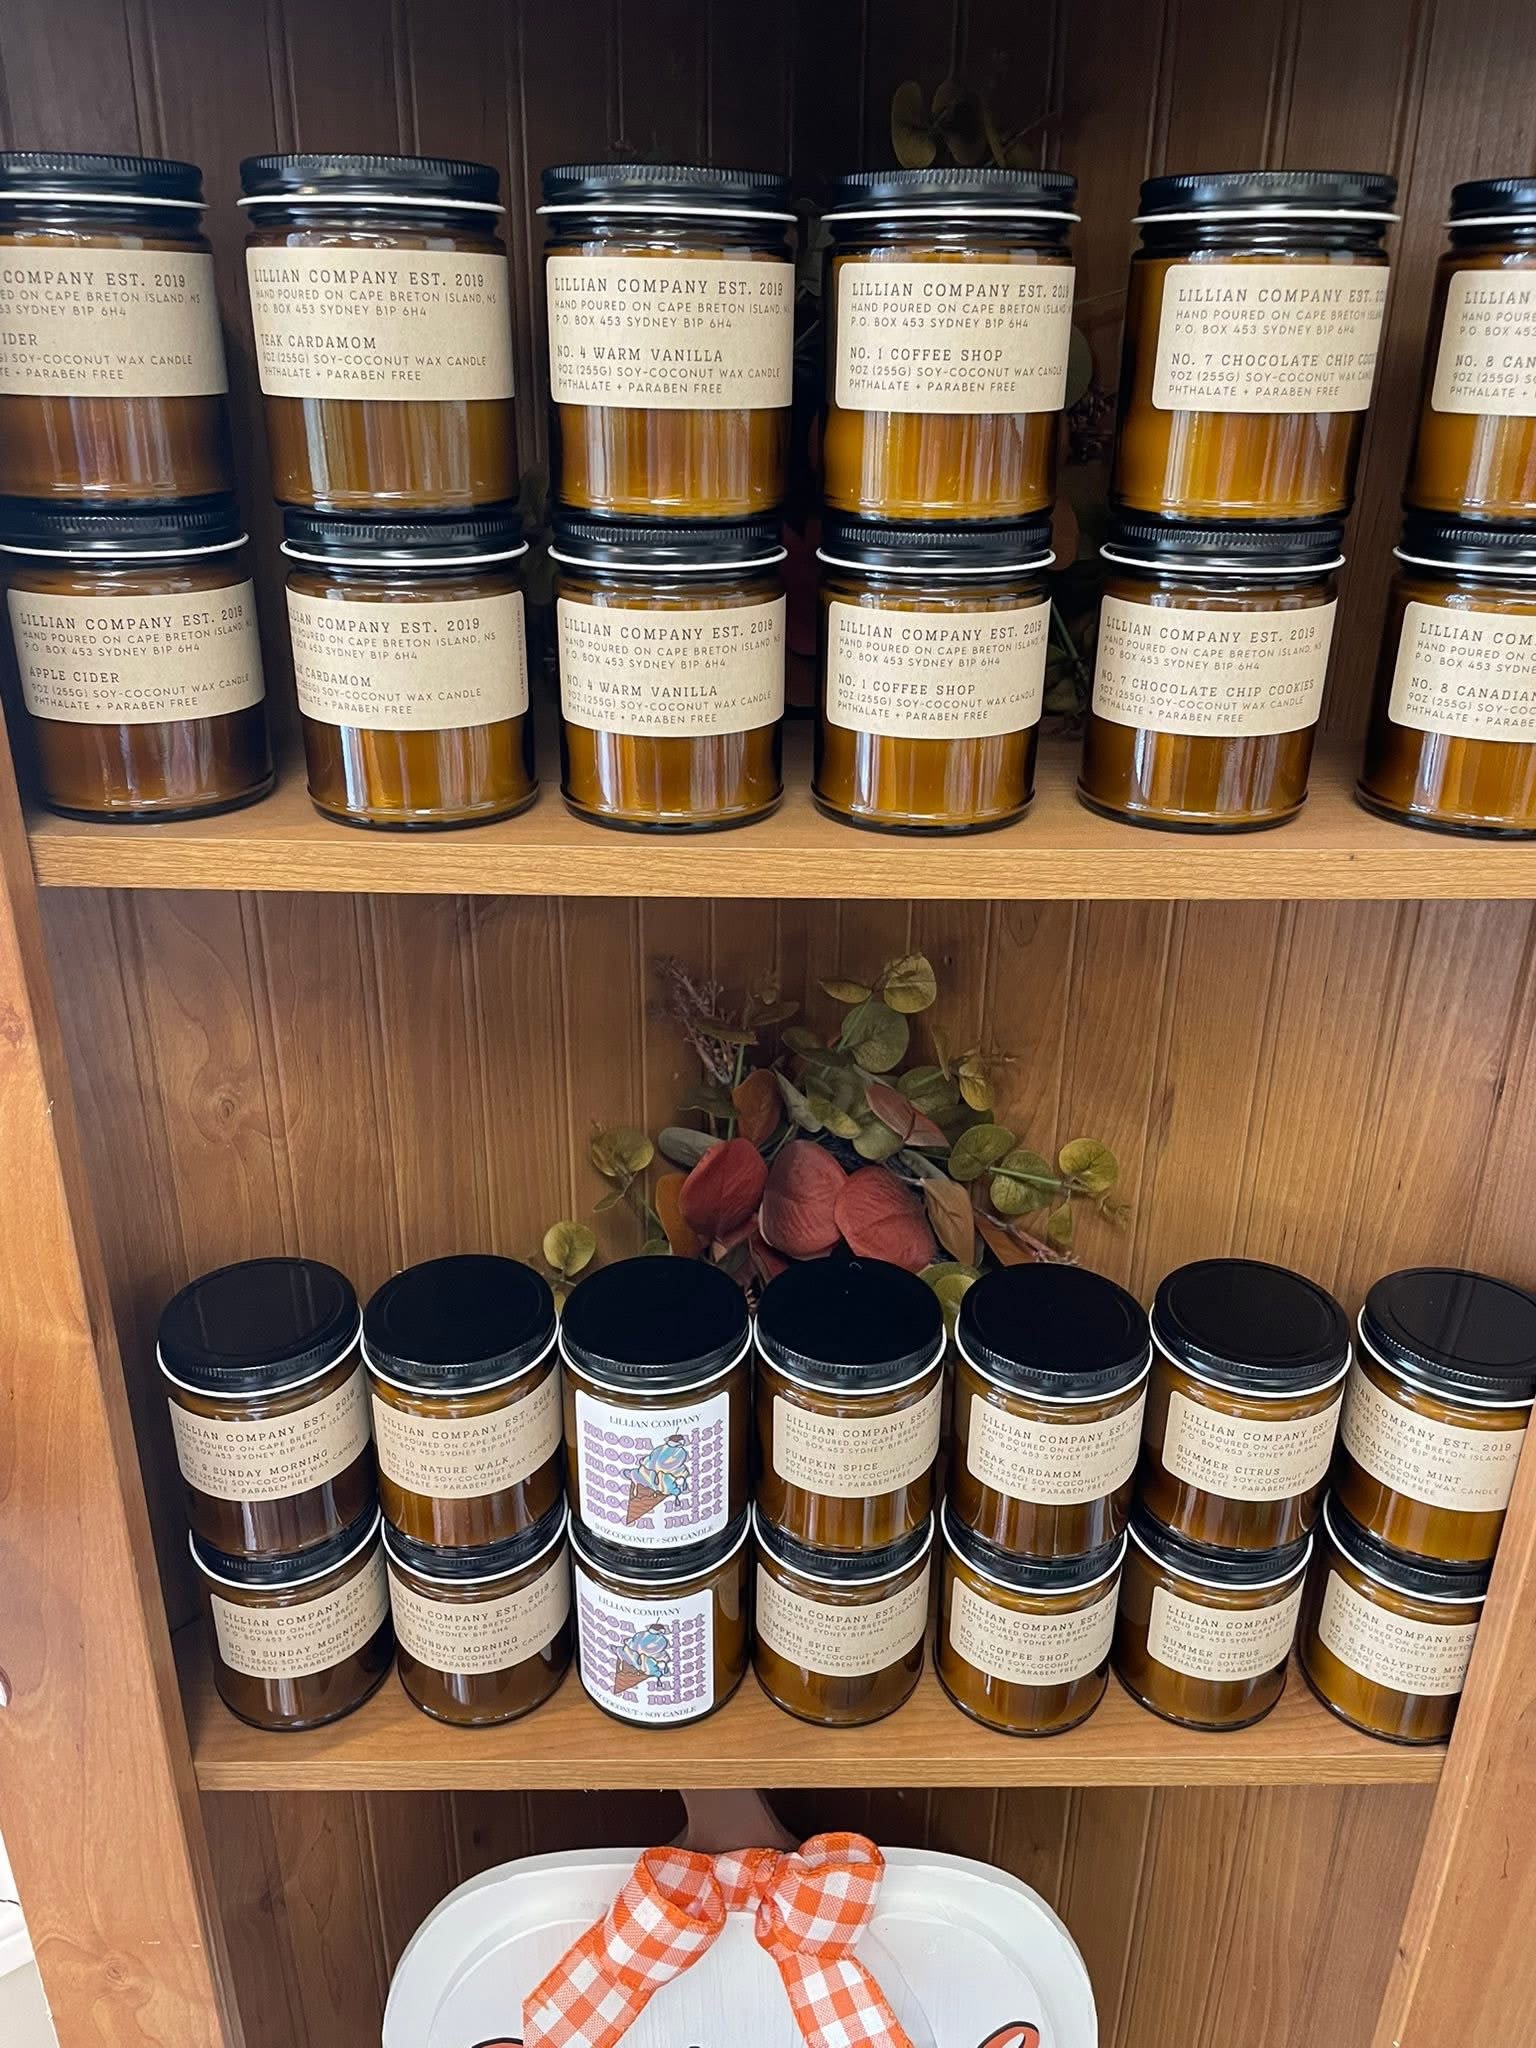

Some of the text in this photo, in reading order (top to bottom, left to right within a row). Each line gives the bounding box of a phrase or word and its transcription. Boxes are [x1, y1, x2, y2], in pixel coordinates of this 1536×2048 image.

[3, 270, 186, 288] COMPANY EST. 2019
[254, 269, 484, 287] LILLIAN COMPANY EST. 2019
[555, 278, 783, 296] LILLIAN COMPANY EST. 2019
[852, 283, 1046, 298] LILLIAN COMPANY EST.
[1179, 289, 1342, 302] LILLIAN COMPANY
[1465, 292, 1531, 304] LILLIAN
[555, 301, 744, 313] HAND POURED ON CAPE BRETON
[575, 316, 732, 328] BOX 453 SYDNEY B1P 6H4
[1462, 312, 1490, 321] HAND
[261, 334, 376, 349] TEAK CARDAMOM
[557, 346, 723, 362] NO. 4 WARM VANILLA
[850, 347, 1003, 361] NO. 1 COFFEE SHOP
[1172, 353, 1195, 365] NO.
[1205, 354, 1212, 365] 7
[1222, 354, 1318, 366] CHOCOLATE
[1326, 354, 1354, 366] CHIP
[1456, 355, 1477, 366] NO.
[1486, 356, 1494, 367] 8
[577, 366, 780, 378] (255G) SOY-COCONUT WAX CANDLE
[559, 379, 722, 393] PHTHALATE PARABEN FREE
[1169, 385, 1340, 396] PHTHALATE PARABEN FREE
[1450, 387, 1515, 397] PHTHALATE
[20, 606, 242, 630] LILLIAN COMPANY EST. 2019
[318, 616, 390, 634] COMPANY
[401, 622, 437, 633] EST.
[448, 618, 480, 631] 2019
[565, 618, 773, 640] LILLIAN COMPANY EST. 2019
[840, 620, 893, 638] LILLIAN
[902, 628, 982, 641] COMPANY
[991, 627, 1018, 640] EST.
[1106, 616, 1315, 643] LILLIAN COMPANY EST. 2019
[1420, 622, 1483, 642] LILLIAN
[383, 632, 496, 648] BRETON NS
[1418, 641, 1525, 660] HAND POURED ON
[30, 666, 120, 683] APPLE CIDER
[305, 667, 371, 687] CARDAMOM
[567, 675, 718, 697] NO. 4 WARM VANILLA
[839, 674, 975, 696] NO. 1 COFFEE SHOP
[1120, 675, 1126, 685] 7
[1132, 678, 1217, 697] CHOCOLATE
[1226, 686, 1261, 697] CHIP
[1268, 679, 1314, 696] COOKIES
[1412, 678, 1448, 693] NO. 8
[838, 701, 988, 721] PHTHALATE PARABEN FREE
[177, 1412, 330, 1442] LILLIAN COMPANY EST.
[382, 1411, 529, 1440] LILLIAN COMPANY EST.
[609, 1414, 702, 1428] LILLIAN COMPANY
[786, 1413, 905, 1438] LILLIAN COMPANY
[983, 1413, 1103, 1444] LILLIAN COMPANY
[1183, 1411, 1307, 1442] LILLIAN COMPANY
[1375, 1404, 1512, 1452] COMPANY EST. 2019
[584, 1421, 654, 1450] moon
[213, 1450, 328, 1477] SUNDAY MORNING
[786, 1448, 878, 1471] PUMPKIN SPICE
[1178, 1445, 1280, 1475] SUMMER CITRUS
[1356, 1426, 1461, 1484] EUCALYPTUS MINT
[421, 1456, 509, 1474] NATURE WALK
[1011, 1464, 1081, 1478] CARDAMOM
[664, 1499, 723, 1529] mist
[223, 1601, 340, 1626] LILLIAN COMPANY
[428, 1605, 522, 1622] COMPANY EST.
[633, 1608, 681, 1616] COMPANY
[808, 1610, 868, 1623] COMPANY
[1168, 1605, 1281, 1629] LILLIAN COMPANY
[1013, 1621, 1074, 1631] COMPANY
[1386, 1624, 1450, 1643] COMPANY
[263, 1615, 366, 1658] SUNDAY MORNING
[416, 1634, 518, 1652] SUNDAY MORNING
[808, 1641, 841, 1652] SPICE
[990, 1644, 1069, 1661] COFFEE SHOP
[1163, 1636, 1259, 1659] SUMMER CITRUS
[1360, 1644, 1436, 1673] EUCALYPTUS
[648, 1684, 706, 1705] mist
